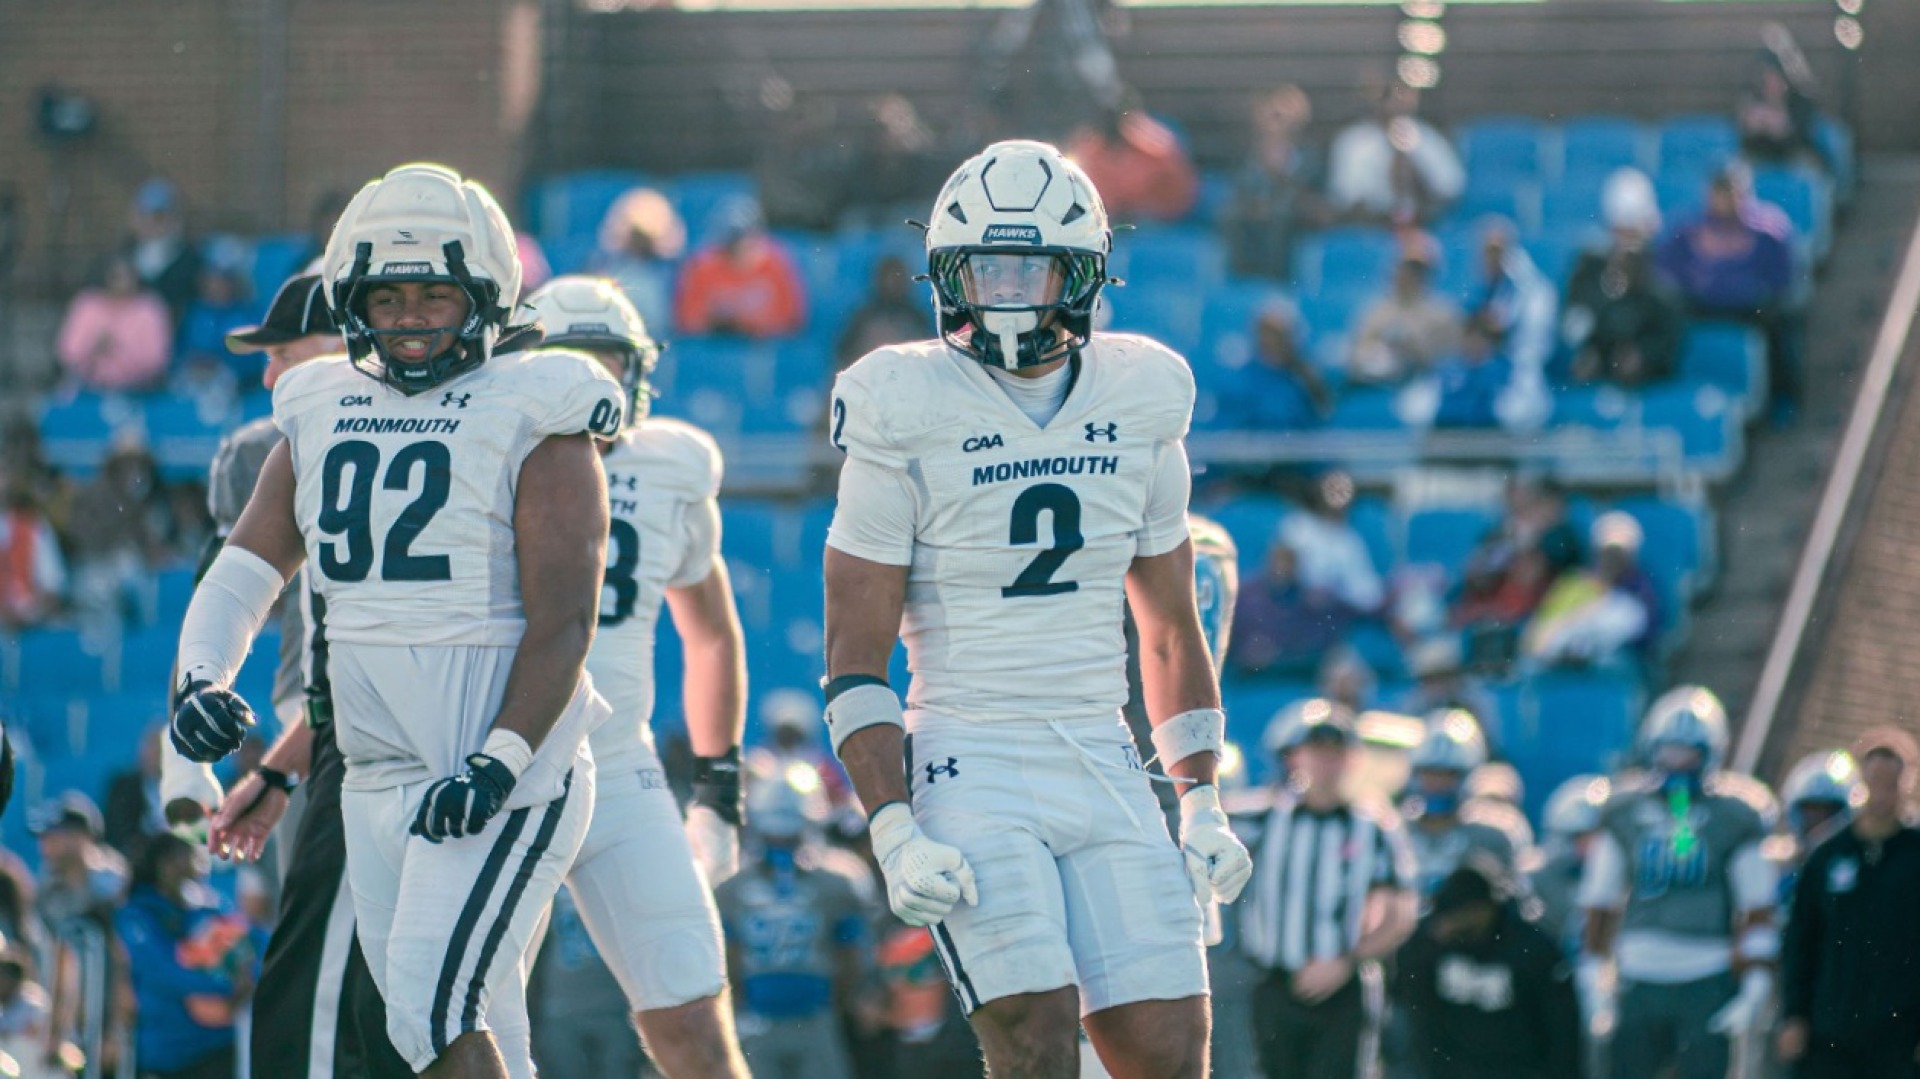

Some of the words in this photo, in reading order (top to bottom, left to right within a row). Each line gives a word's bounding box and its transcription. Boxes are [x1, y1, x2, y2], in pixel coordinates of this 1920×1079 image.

[988, 228, 1036, 238] HAWKS
[385, 264, 430, 274] HAWKS
[340, 395, 372, 406] CAA
[333, 417, 461, 434] MONMOUTH
[963, 434, 1004, 453] CAA
[972, 455, 1119, 486] MONMOUTH
[319, 440, 452, 583] 92
[1001, 482, 1085, 598] 2
